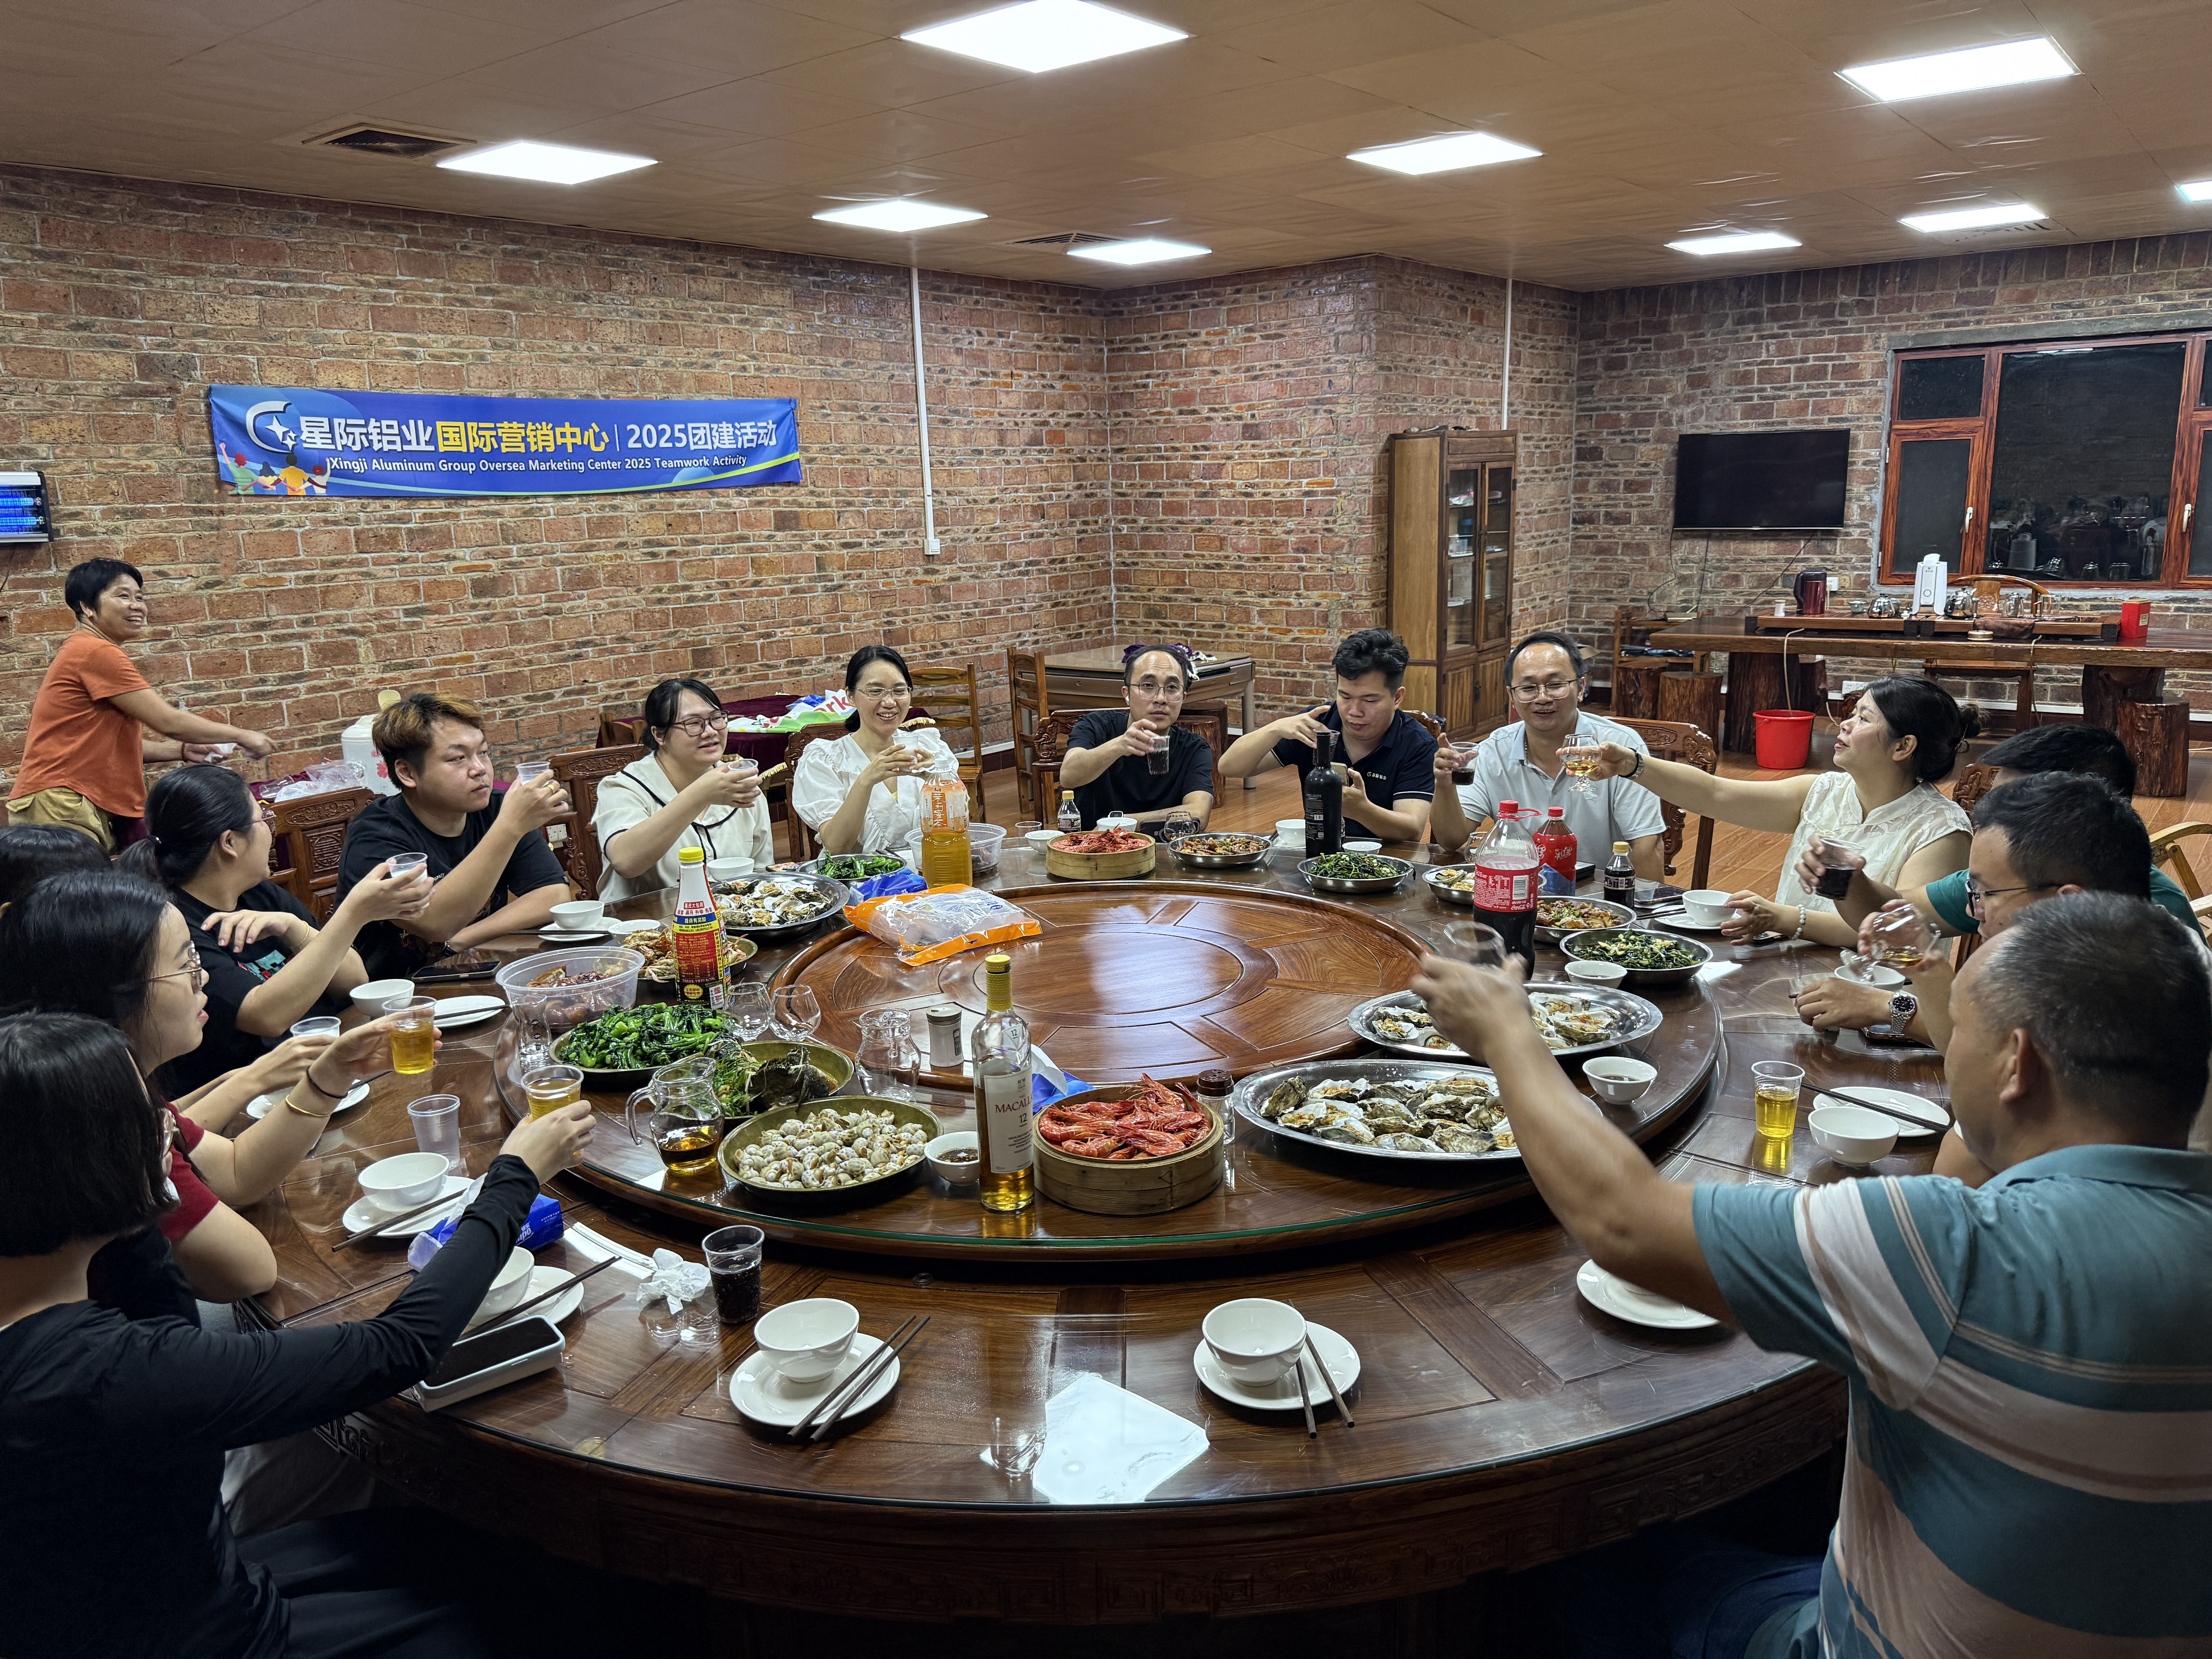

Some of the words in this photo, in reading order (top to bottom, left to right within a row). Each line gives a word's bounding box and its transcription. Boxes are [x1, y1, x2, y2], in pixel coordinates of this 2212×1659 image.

[627, 420, 777, 450] 2025团建活动
[330, 457, 368, 473] Xingji
[372, 459, 435, 471] Aluminum
[439, 459, 476, 474] Group
[479, 459, 525, 471] Oversea
[529, 459, 585, 473] Marketing
[588, 459, 620, 470] Center
[624, 458, 651, 469] 2025
[654, 456, 709, 468] Teamwork
[713, 454, 747, 467] Activity
[1019, 1113, 1027, 1123] 12
